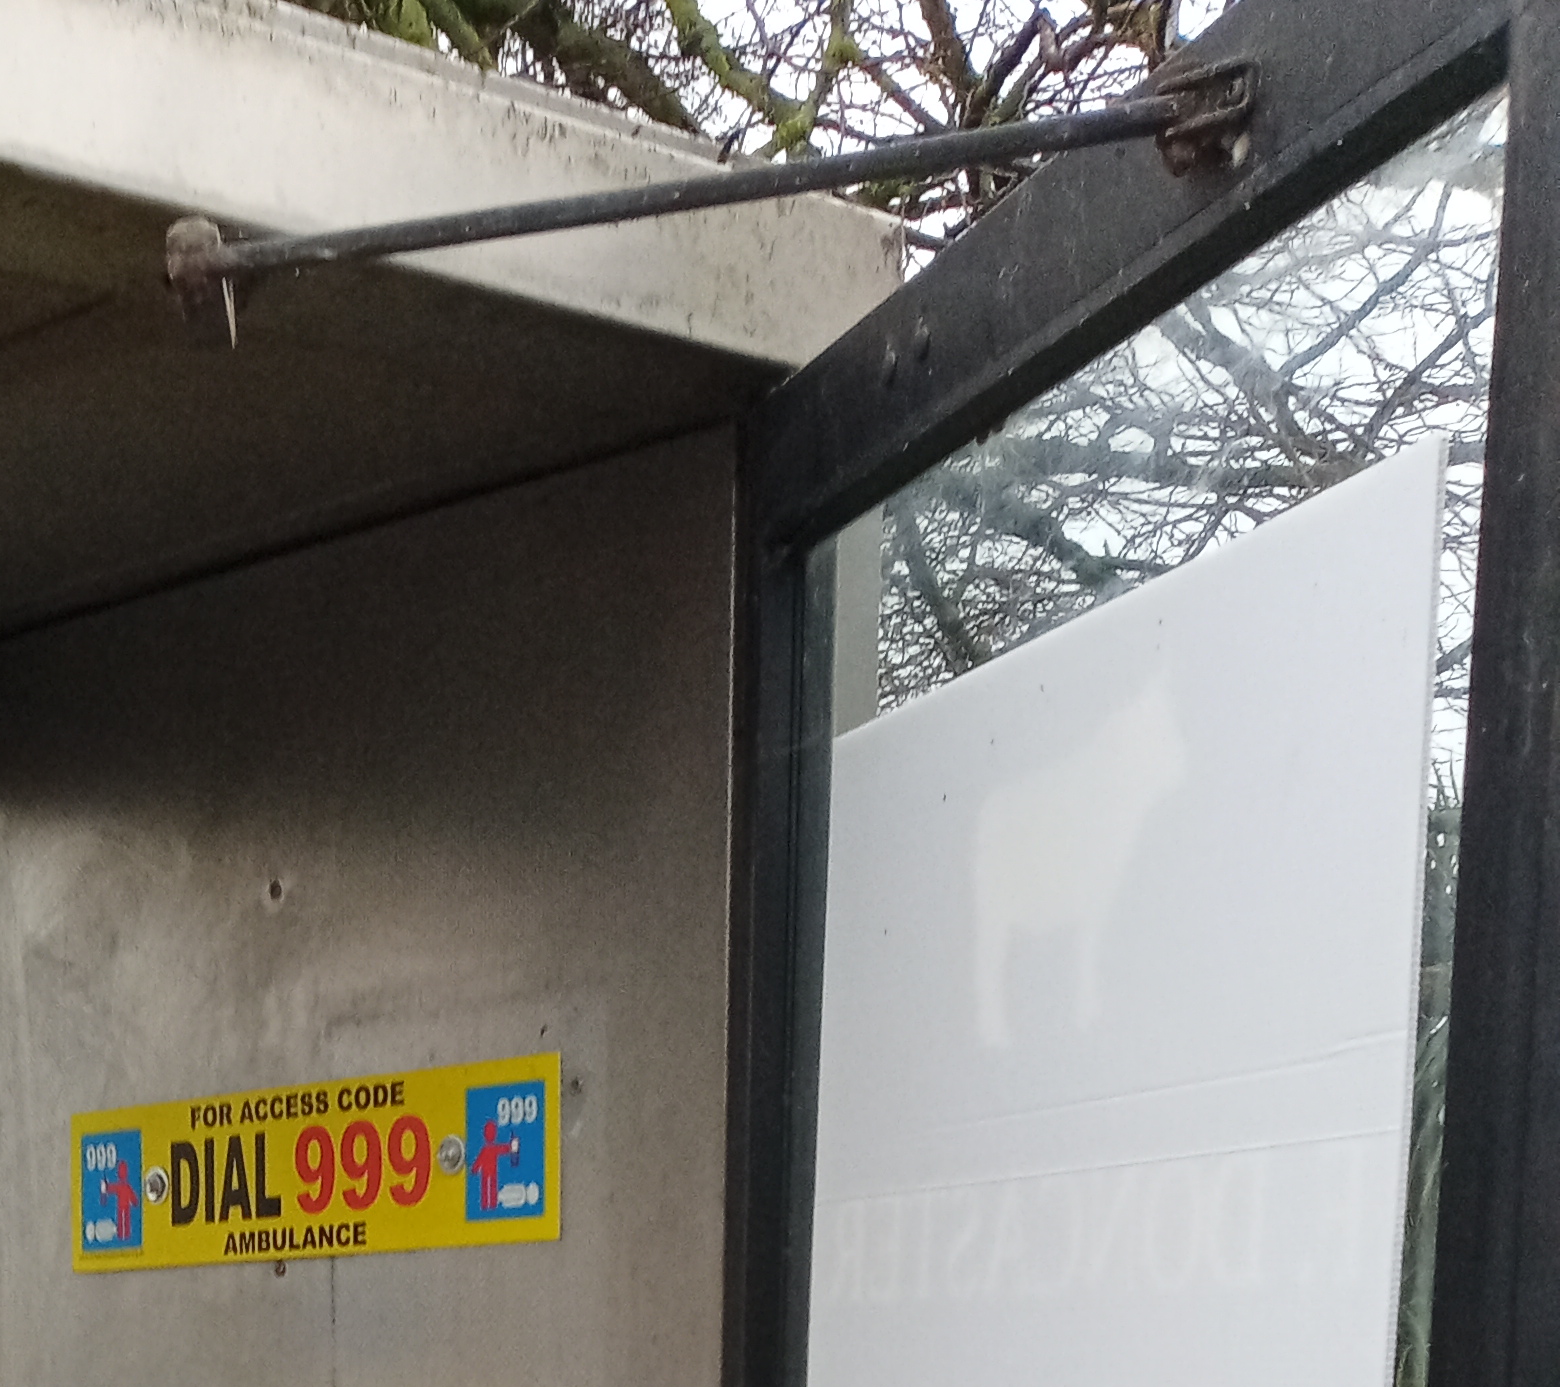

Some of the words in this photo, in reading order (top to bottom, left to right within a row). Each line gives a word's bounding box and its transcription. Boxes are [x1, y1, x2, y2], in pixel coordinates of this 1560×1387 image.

[190, 1104, 233, 1131] FOR
[240, 1089, 329, 1125] ACCESS
[337, 1079, 406, 1113] CODE
[496, 1094, 539, 1128] 999
[85, 1141, 118, 1172] 999
[170, 1130, 282, 1227] DIAL
[294, 1114, 432, 1215] 999
[223, 1220, 367, 1257] AMBULANCE
